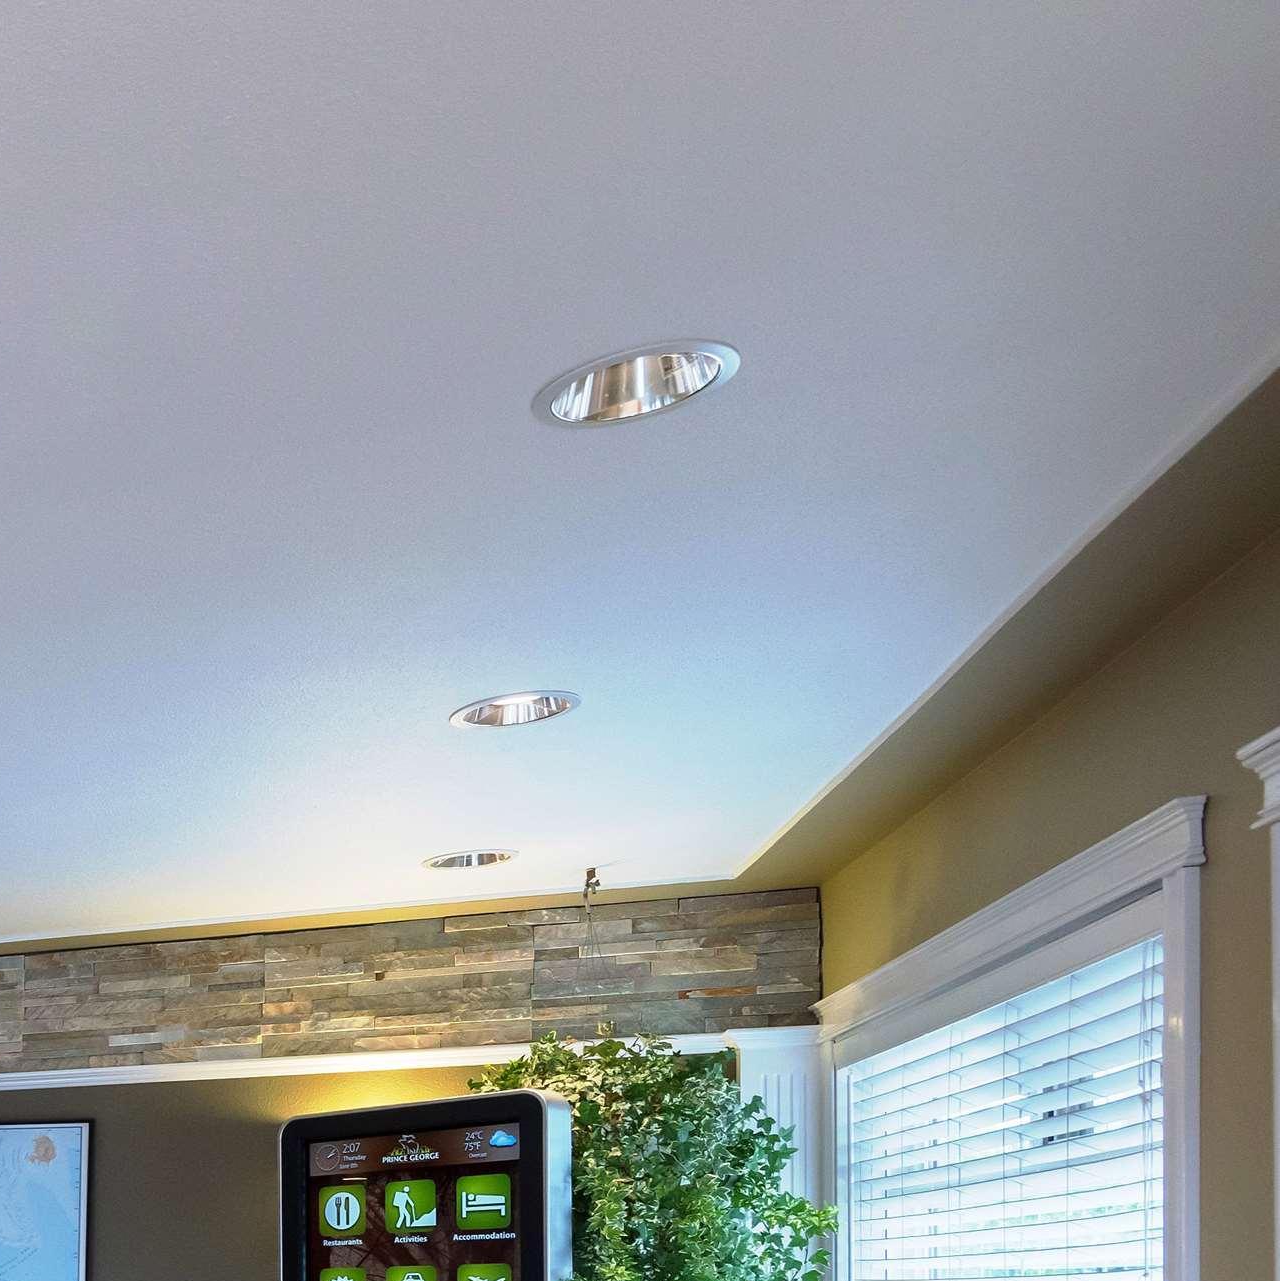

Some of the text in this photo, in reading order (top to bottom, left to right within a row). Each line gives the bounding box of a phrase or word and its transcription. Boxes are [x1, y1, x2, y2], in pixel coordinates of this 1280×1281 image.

[342, 1143, 361, 1153] 2:07
[382, 1152, 439, 1163] PRINCE GEORGE
[394, 1235, 428, 1243] Activities
[453, 1231, 516, 1241] Accommodation
